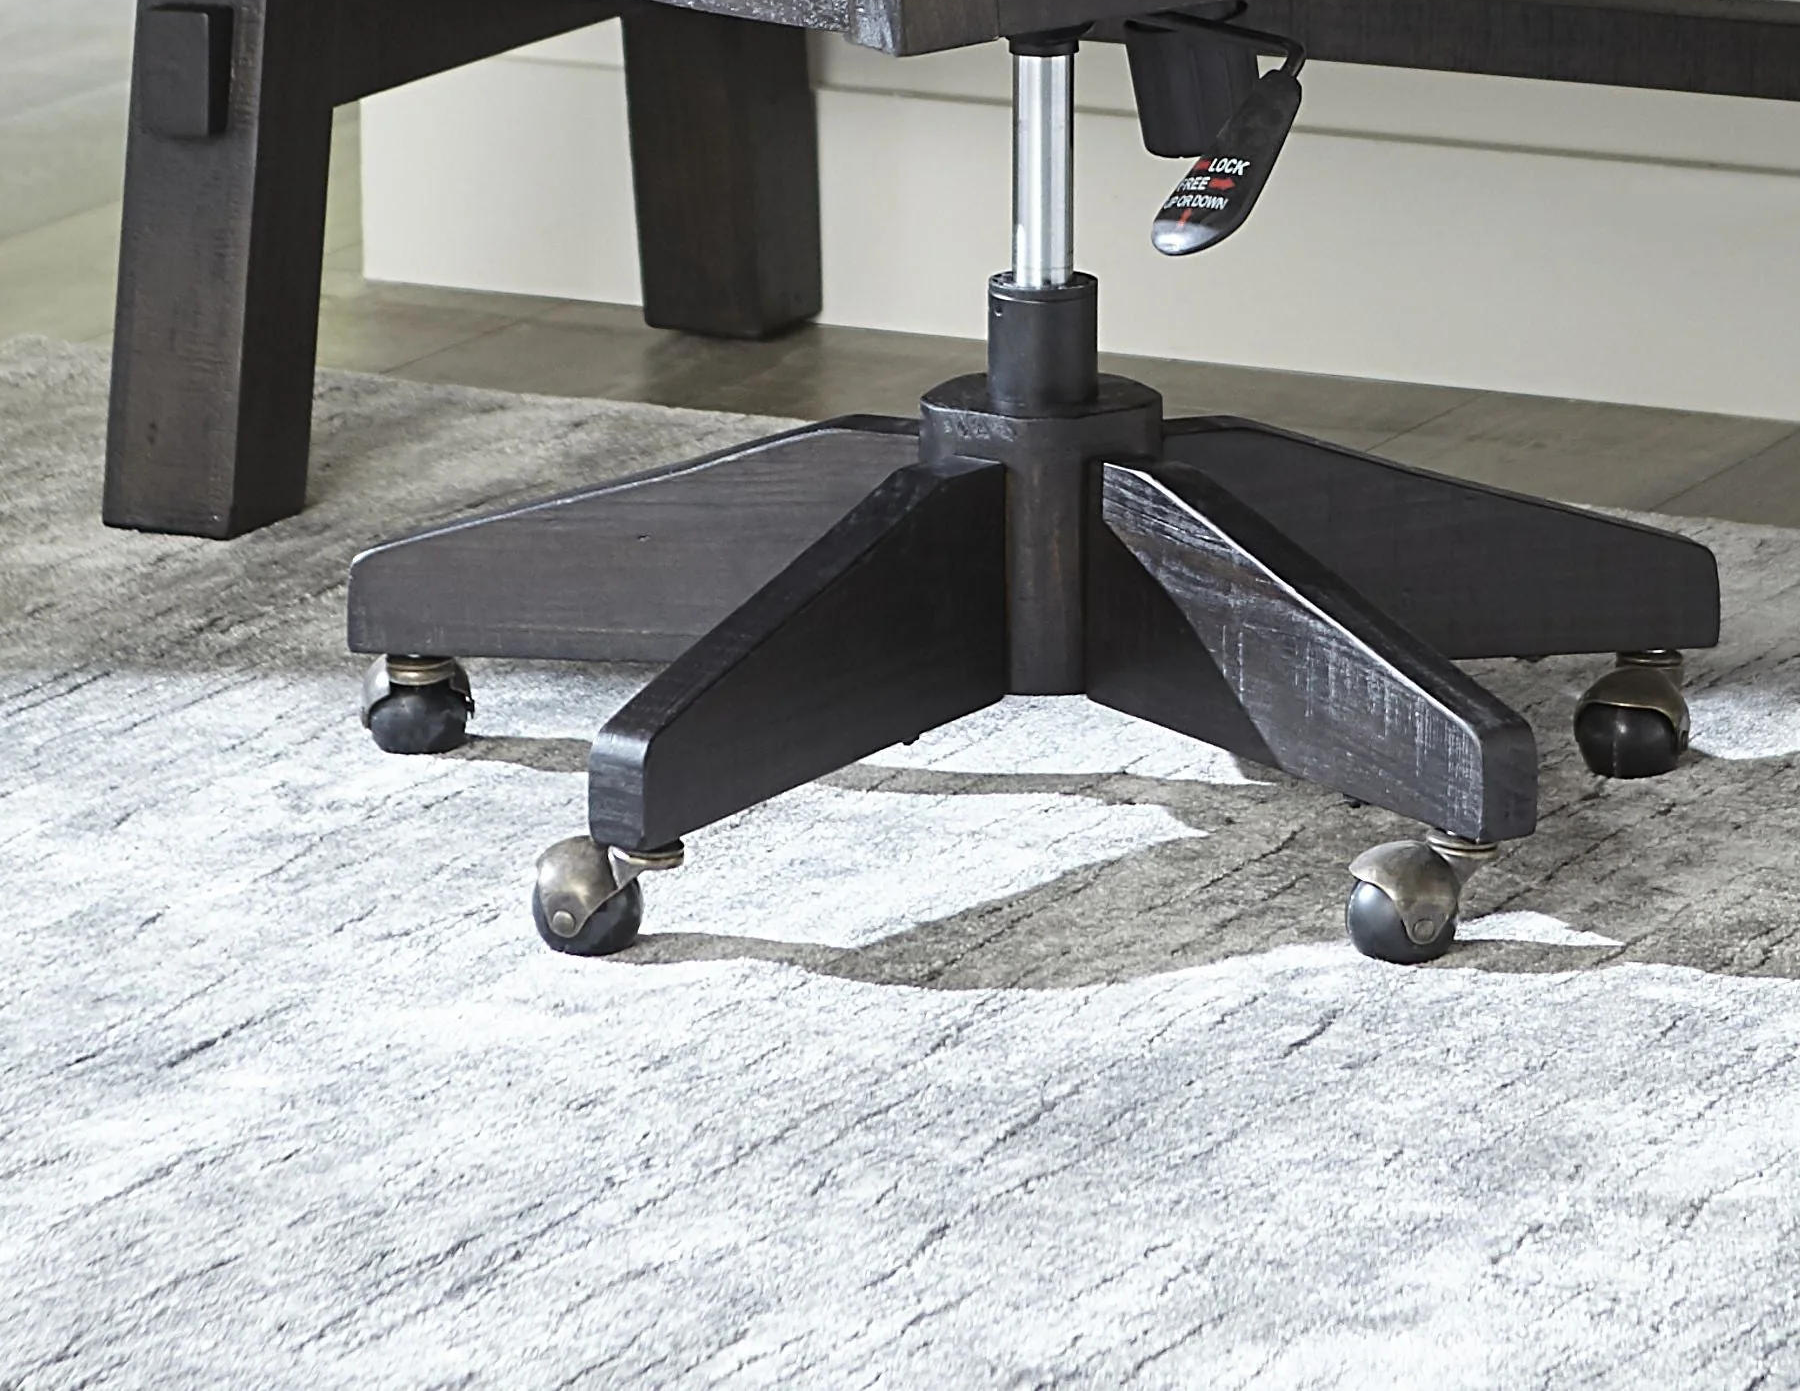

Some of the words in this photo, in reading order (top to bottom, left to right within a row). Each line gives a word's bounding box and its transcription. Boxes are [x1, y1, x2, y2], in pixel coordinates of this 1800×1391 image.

[1208, 158, 1250, 176] LOCK
[1177, 176, 1211, 192] FREE
[1191, 194, 1229, 210] DOWN
